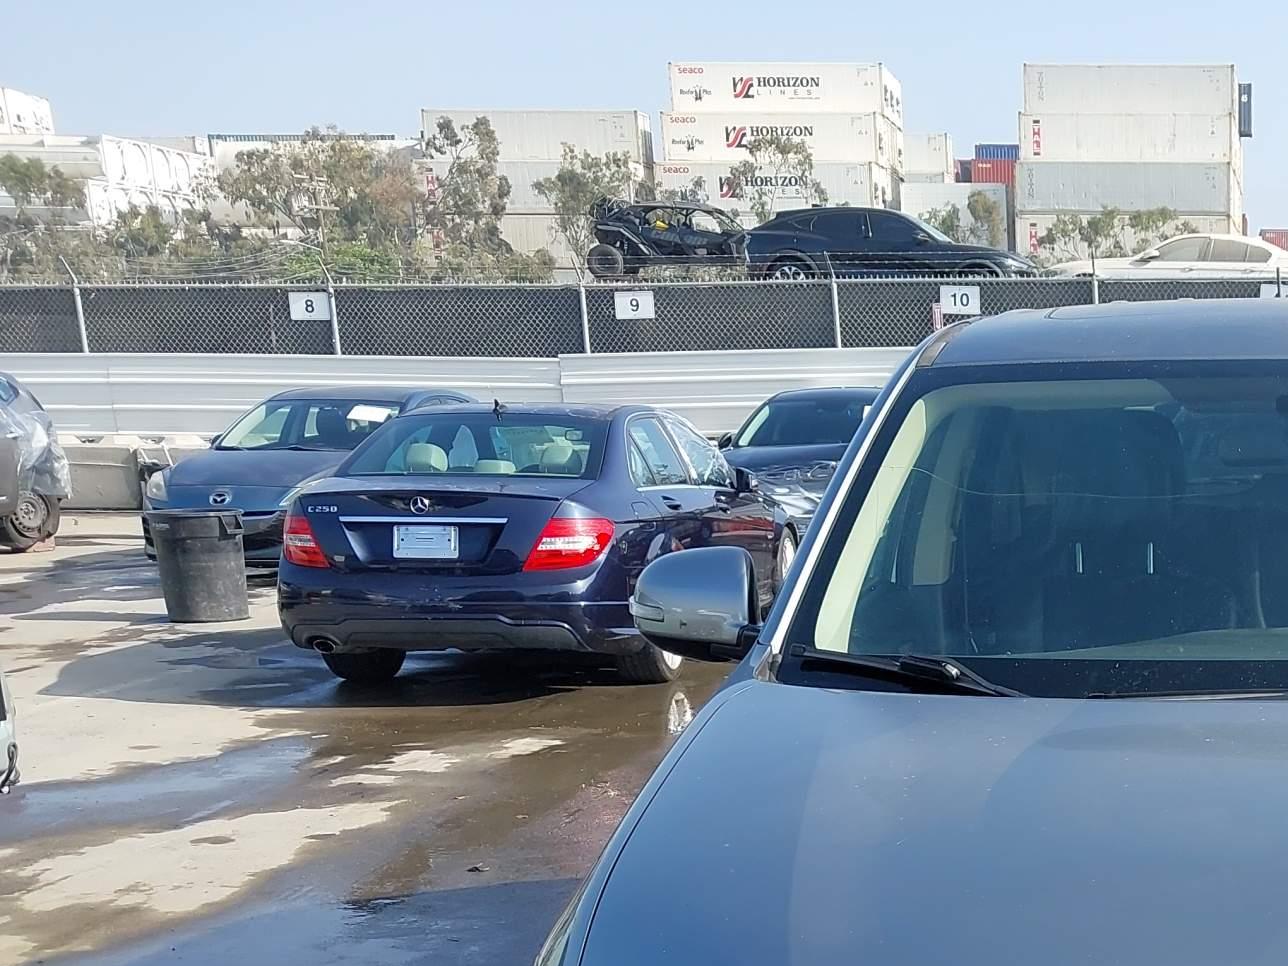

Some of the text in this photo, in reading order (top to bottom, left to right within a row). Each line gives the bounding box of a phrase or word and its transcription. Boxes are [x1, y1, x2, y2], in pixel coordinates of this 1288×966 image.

[757, 77, 820, 87] HORIZON
[757, 88, 812, 96] LINES
[670, 116, 696, 124] seaco
[750, 126, 814, 136] HORIZON
[663, 166, 690, 174] seaco
[744, 176, 808, 187] HORIZON
[630, 298, 640, 312] 9
[950, 293, 970, 307] 10
[304, 299, 315, 313] 8
